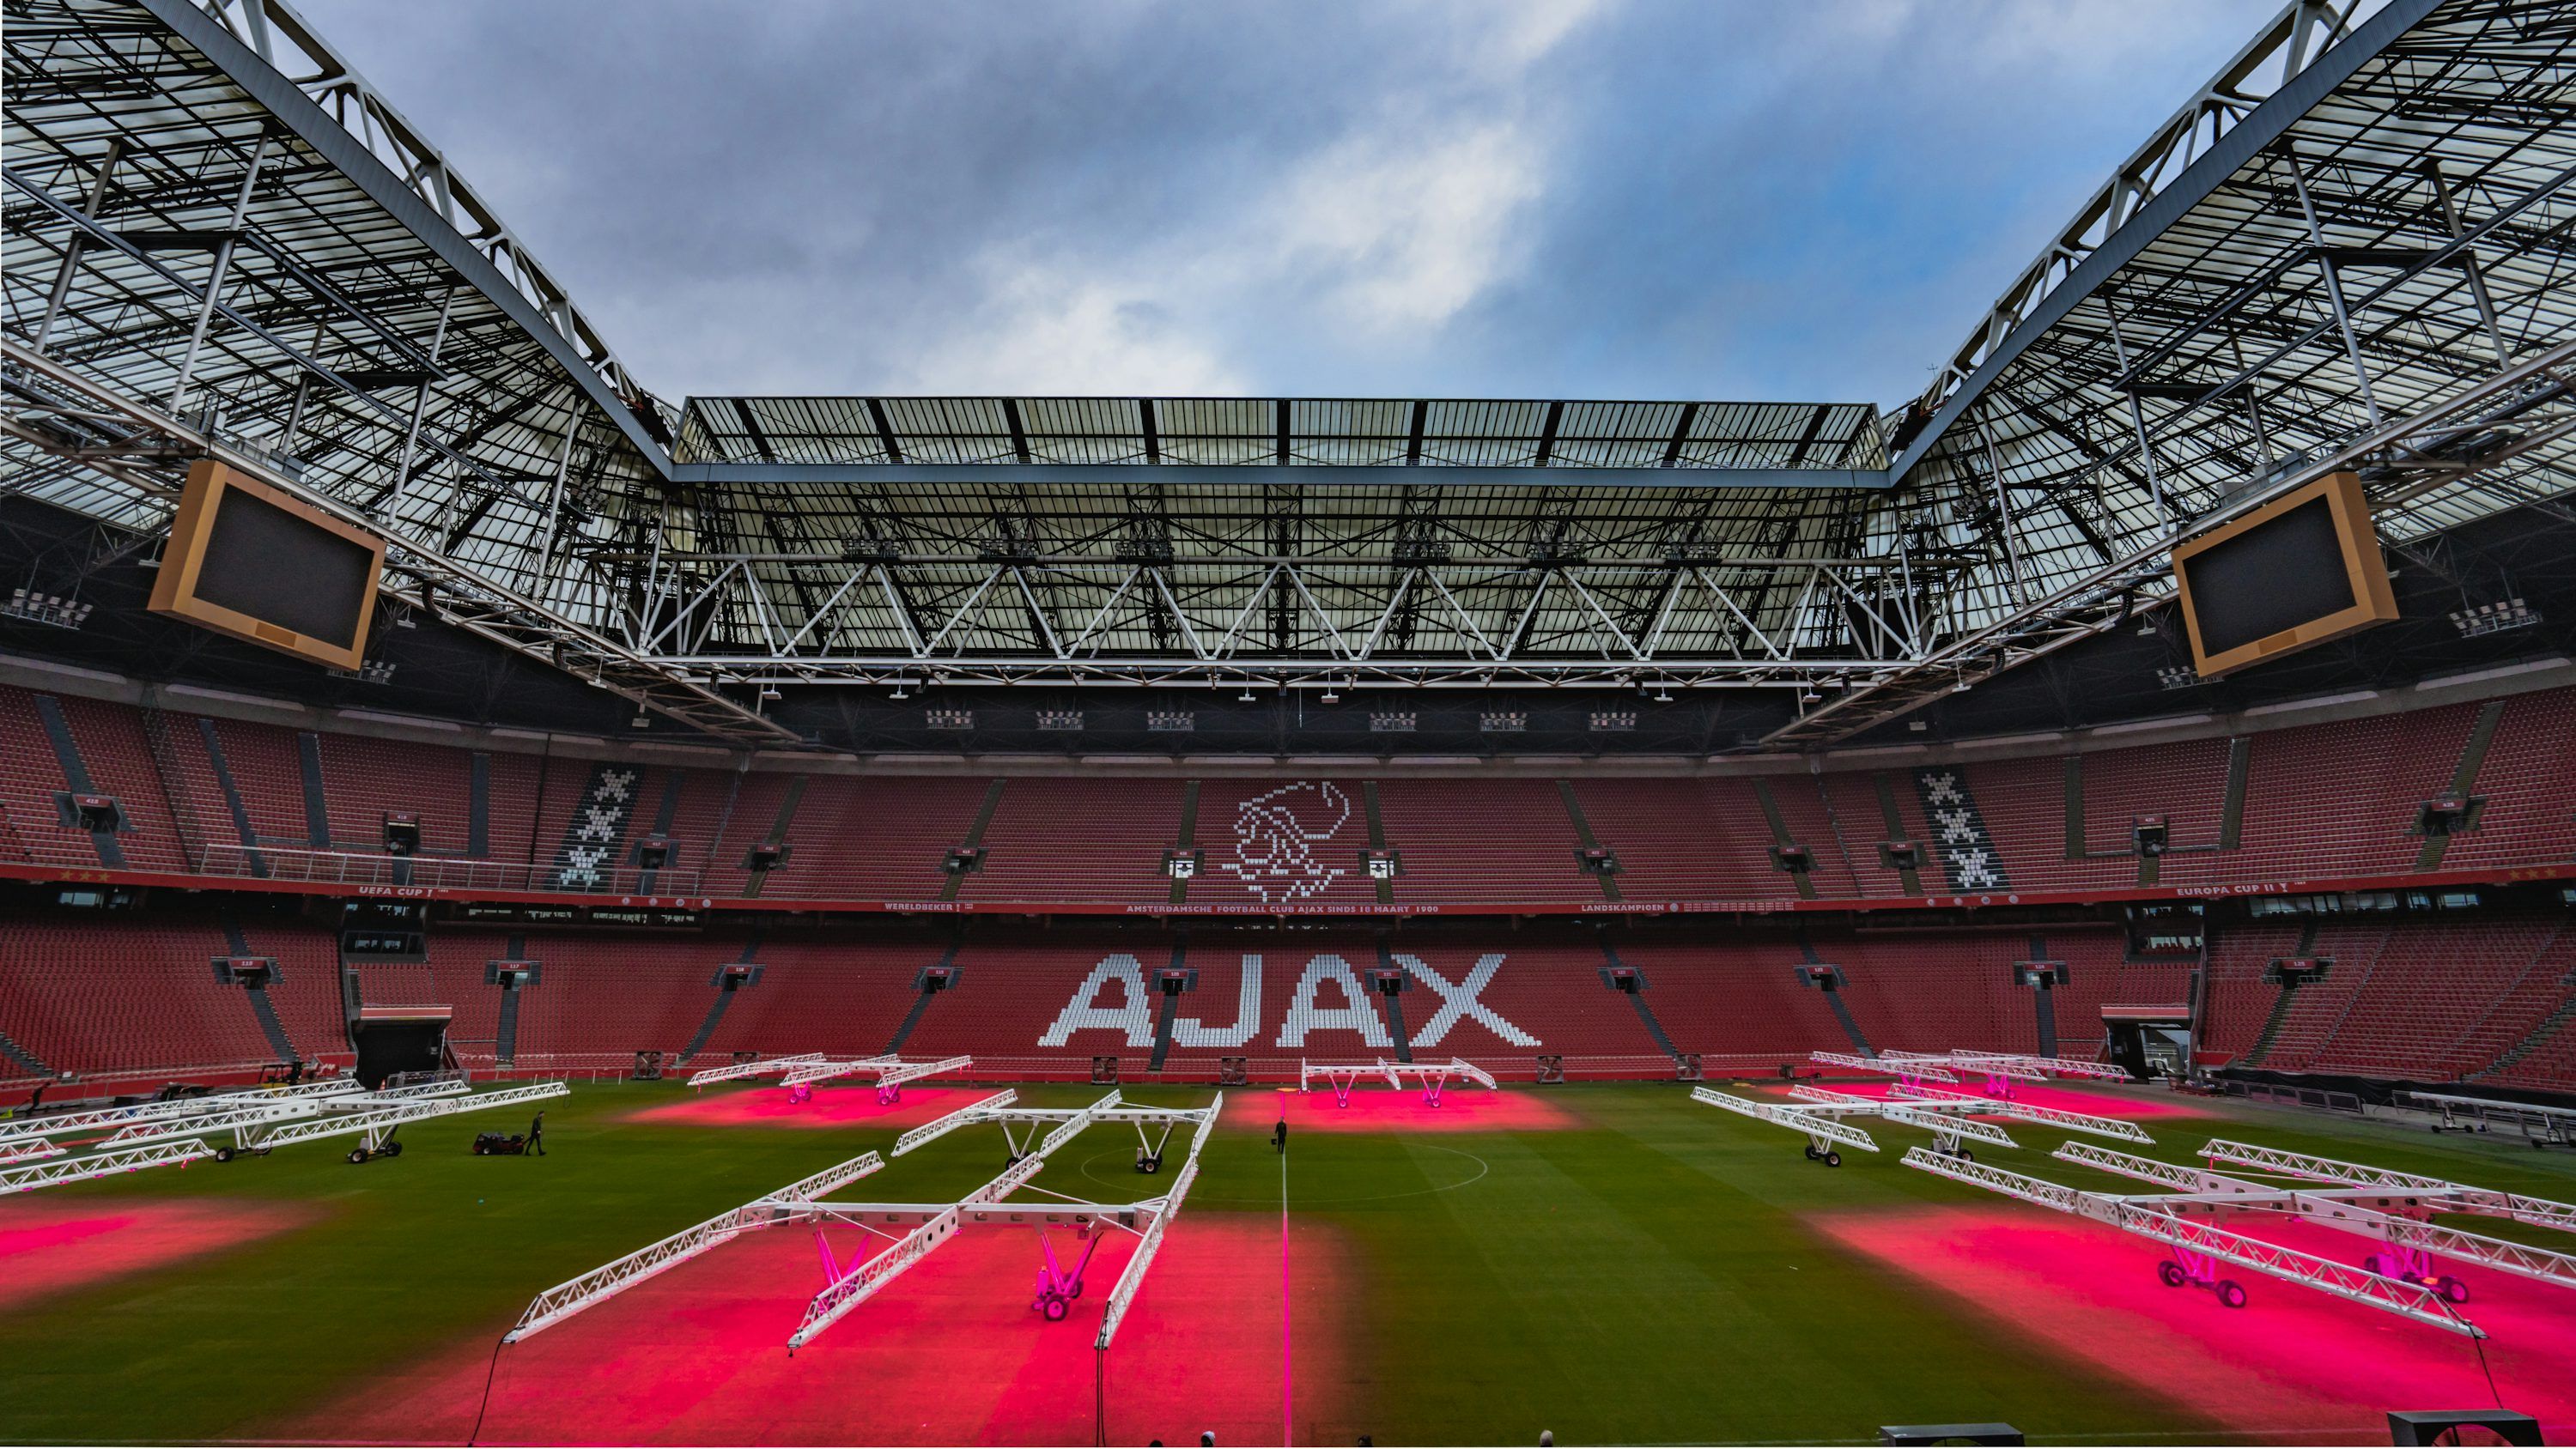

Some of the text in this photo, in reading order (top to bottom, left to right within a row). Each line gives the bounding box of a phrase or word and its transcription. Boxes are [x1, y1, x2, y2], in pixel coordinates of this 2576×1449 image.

[359, 886, 422, 896] UEFA CUP
[2177, 886, 2230, 896] EUROPA
[2234, 884, 2260, 894] CUP
[1297, 906, 1324, 914] AJAX
[1037, 954, 1542, 1048] AJAX
